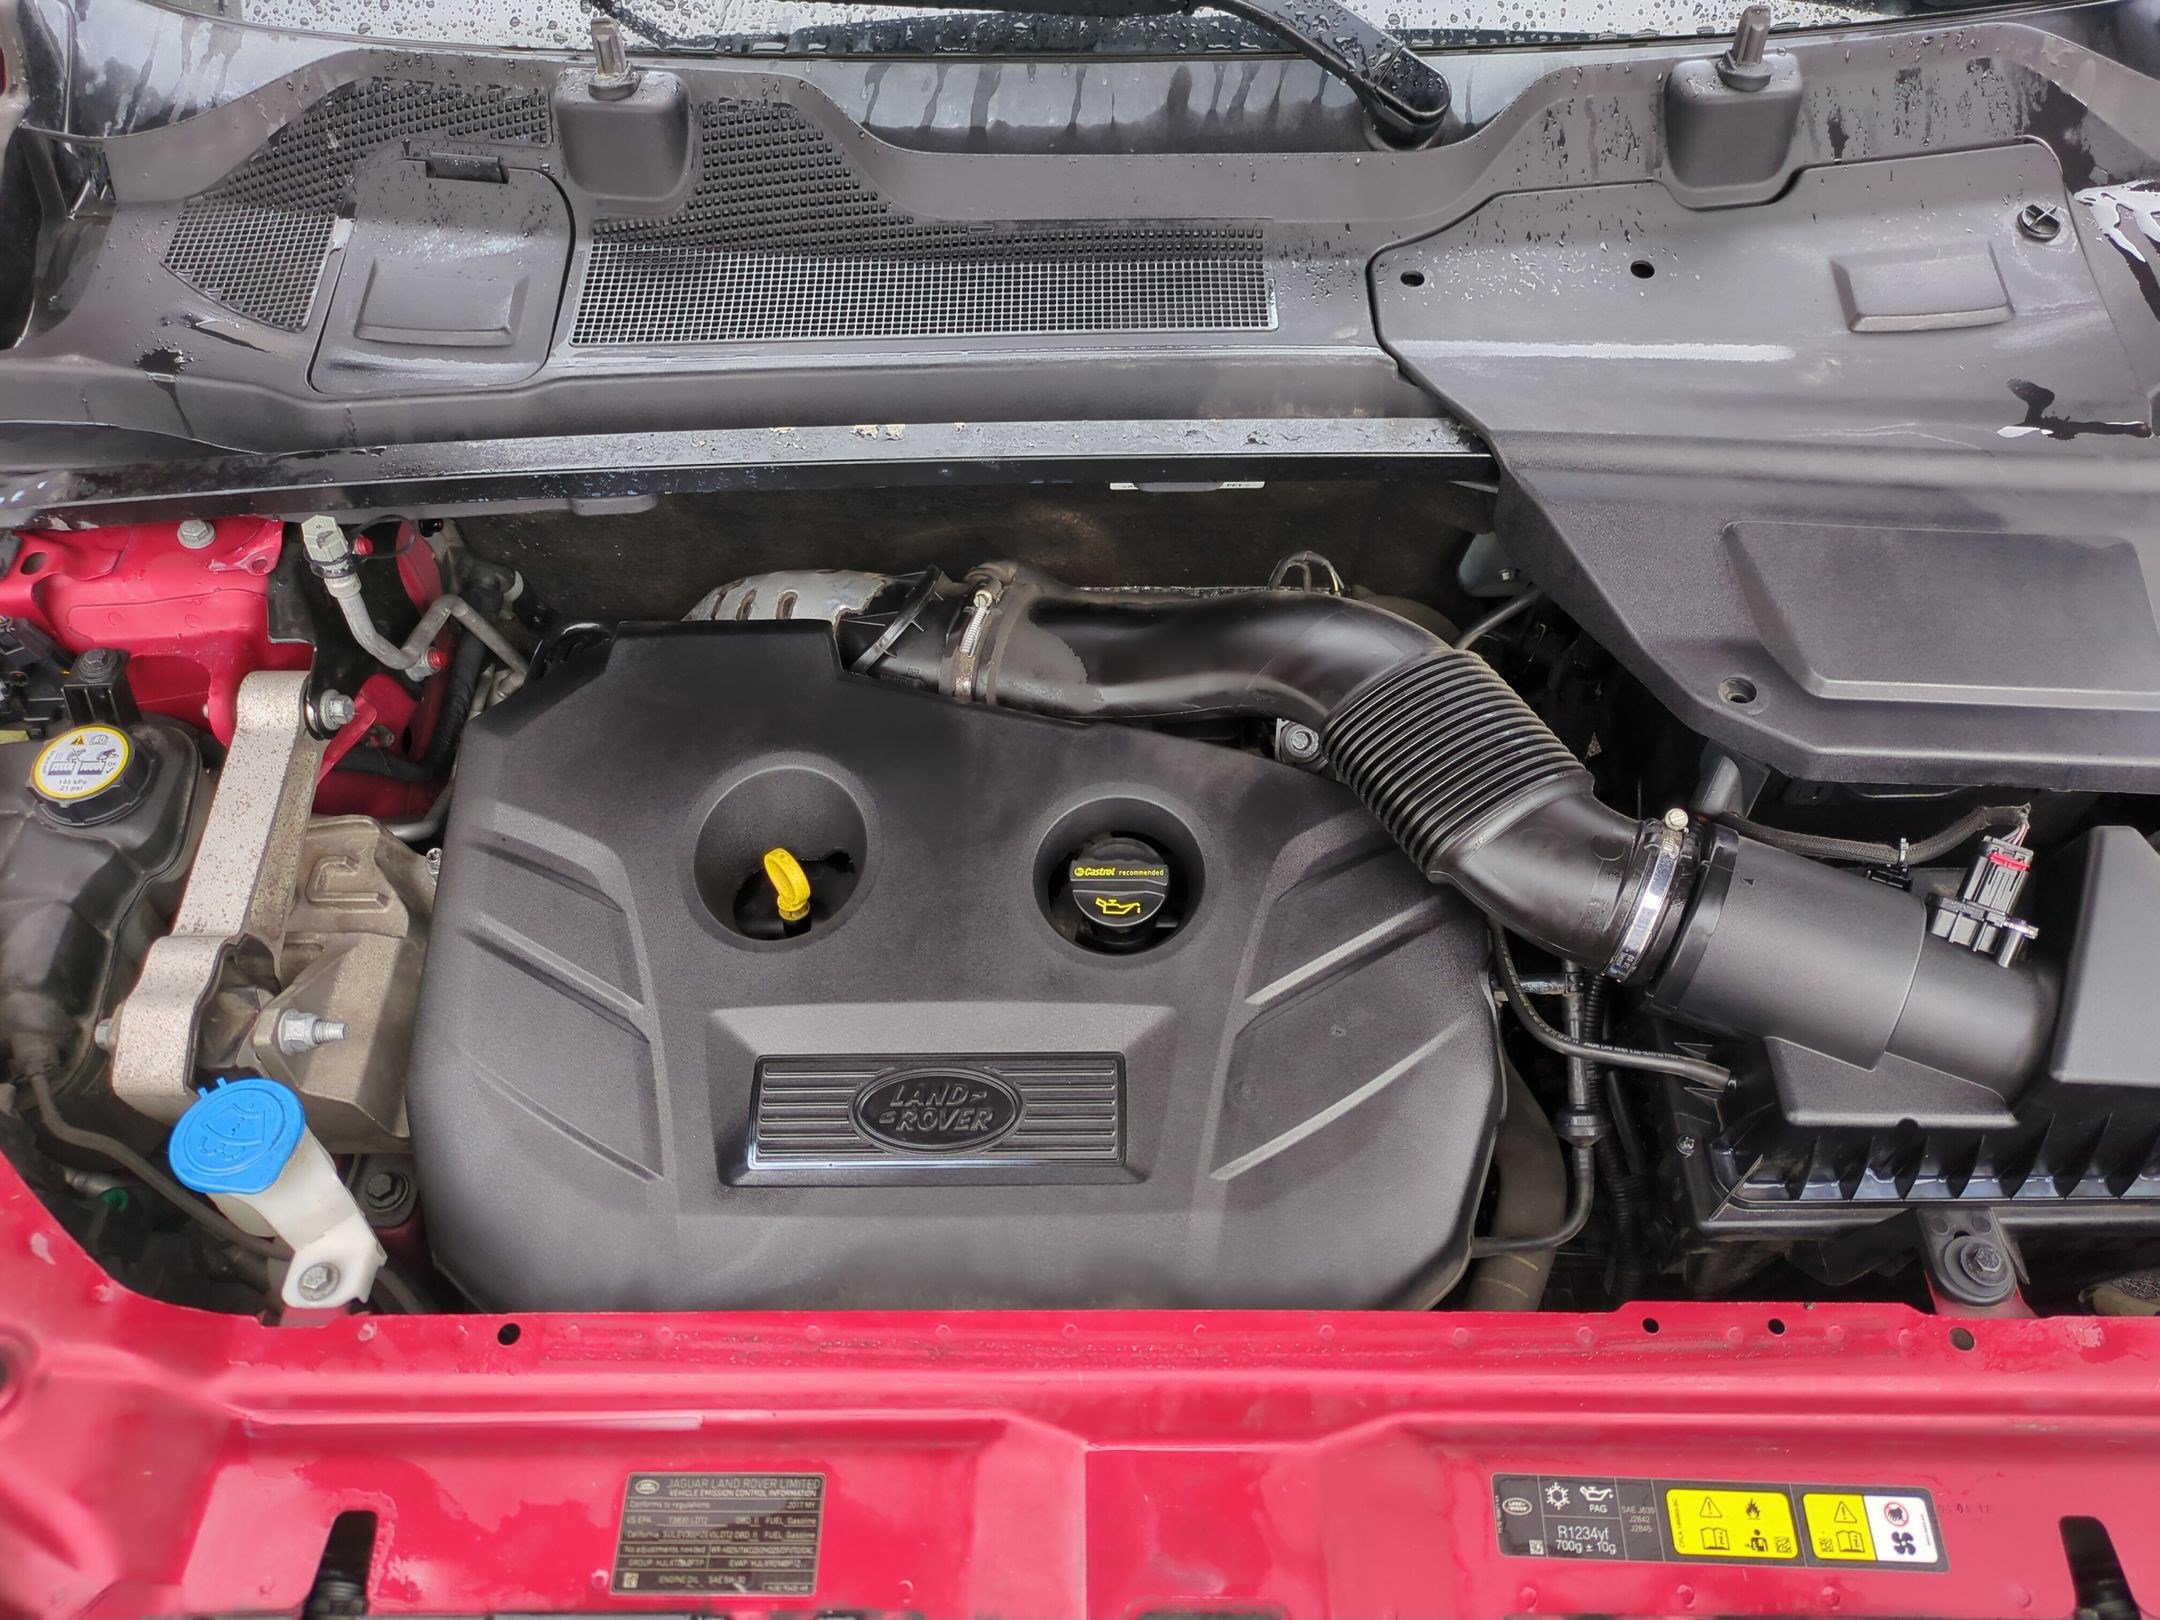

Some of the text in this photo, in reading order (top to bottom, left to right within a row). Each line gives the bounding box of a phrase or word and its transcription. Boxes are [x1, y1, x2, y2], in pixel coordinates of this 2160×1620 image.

[1084, 867, 1116, 877] Castrol
[890, 1083, 968, 1107] LAND
[895, 1107, 995, 1132] ROVER
[667, 1479, 820, 1489] JAGUAR LAND ROVER LIMITED
[769, 1490, 817, 1498] INFORMATION
[672, 1500, 710, 1510] regulations
[787, 1501, 816, 1509] 2017 MY
[1589, 1505, 1608, 1513] PAG
[1621, 1506, 1637, 1514] SAE
[766, 1517, 782, 1525] FUEL
[1557, 1525, 1610, 1543] R1234yf
[1555, 1540, 1582, 1554] 700g
[1597, 1541, 1617, 1556] 10g
